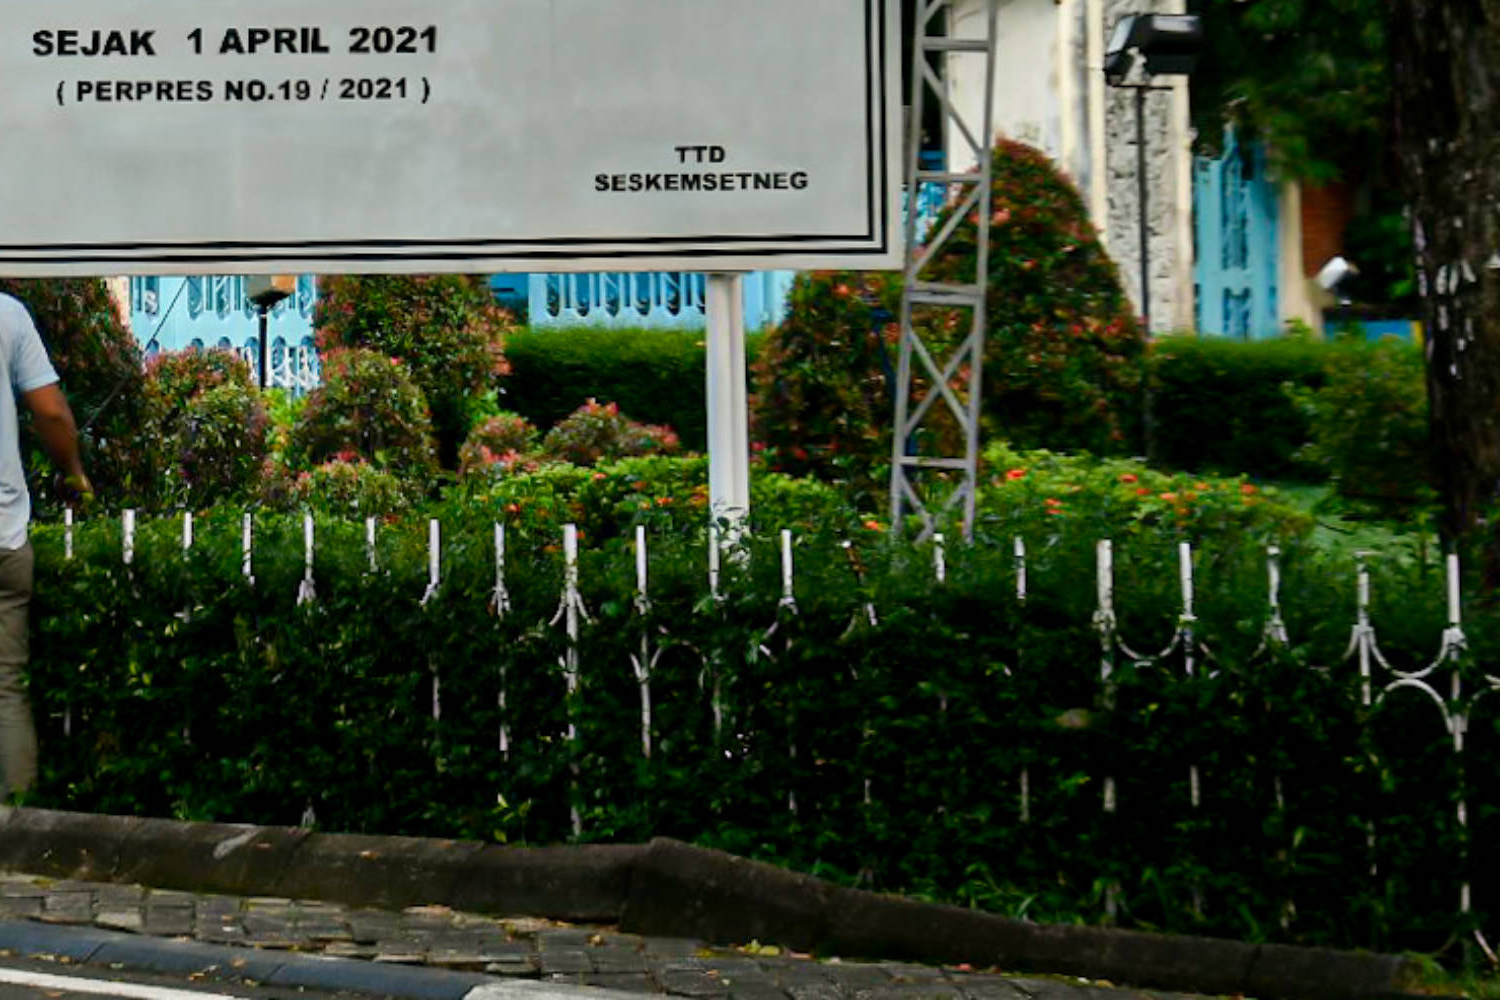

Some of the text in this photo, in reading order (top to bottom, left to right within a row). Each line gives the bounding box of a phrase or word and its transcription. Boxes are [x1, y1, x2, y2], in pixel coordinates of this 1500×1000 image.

[32, 26, 438, 57] SEJAK 1 APRIL 2021
[77, 80, 213, 102] PERPRES
[225, 79, 311, 102] NO.19
[339, 77, 407, 100] 2021
[674, 145, 726, 164] TTD
[594, 172, 808, 192] SESKEMSETNEG
